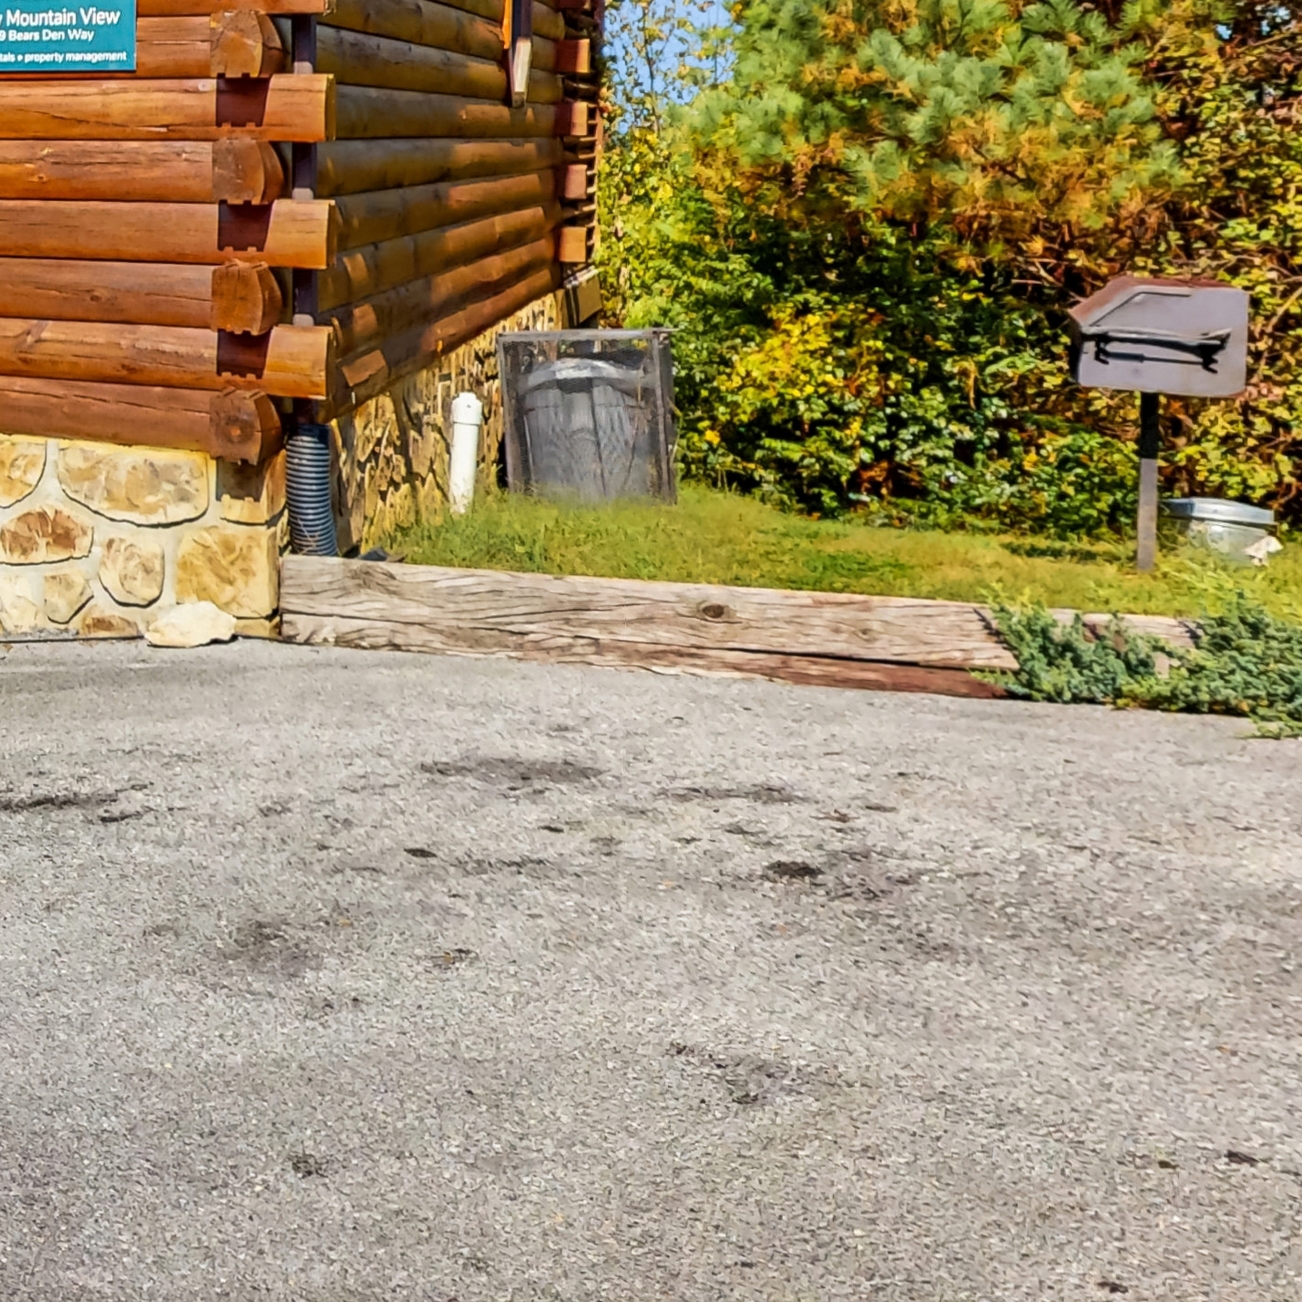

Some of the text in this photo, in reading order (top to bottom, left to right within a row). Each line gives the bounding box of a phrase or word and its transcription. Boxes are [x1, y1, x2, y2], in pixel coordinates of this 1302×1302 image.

[6, 8, 77, 27] Mountain
[79, 6, 121, 26] View
[9, 29, 40, 42] Bears
[42, 29, 65, 41] Den
[67, 28, 95, 42] Way
[24, 51, 64, 64] property
[65, 51, 127, 64] management
